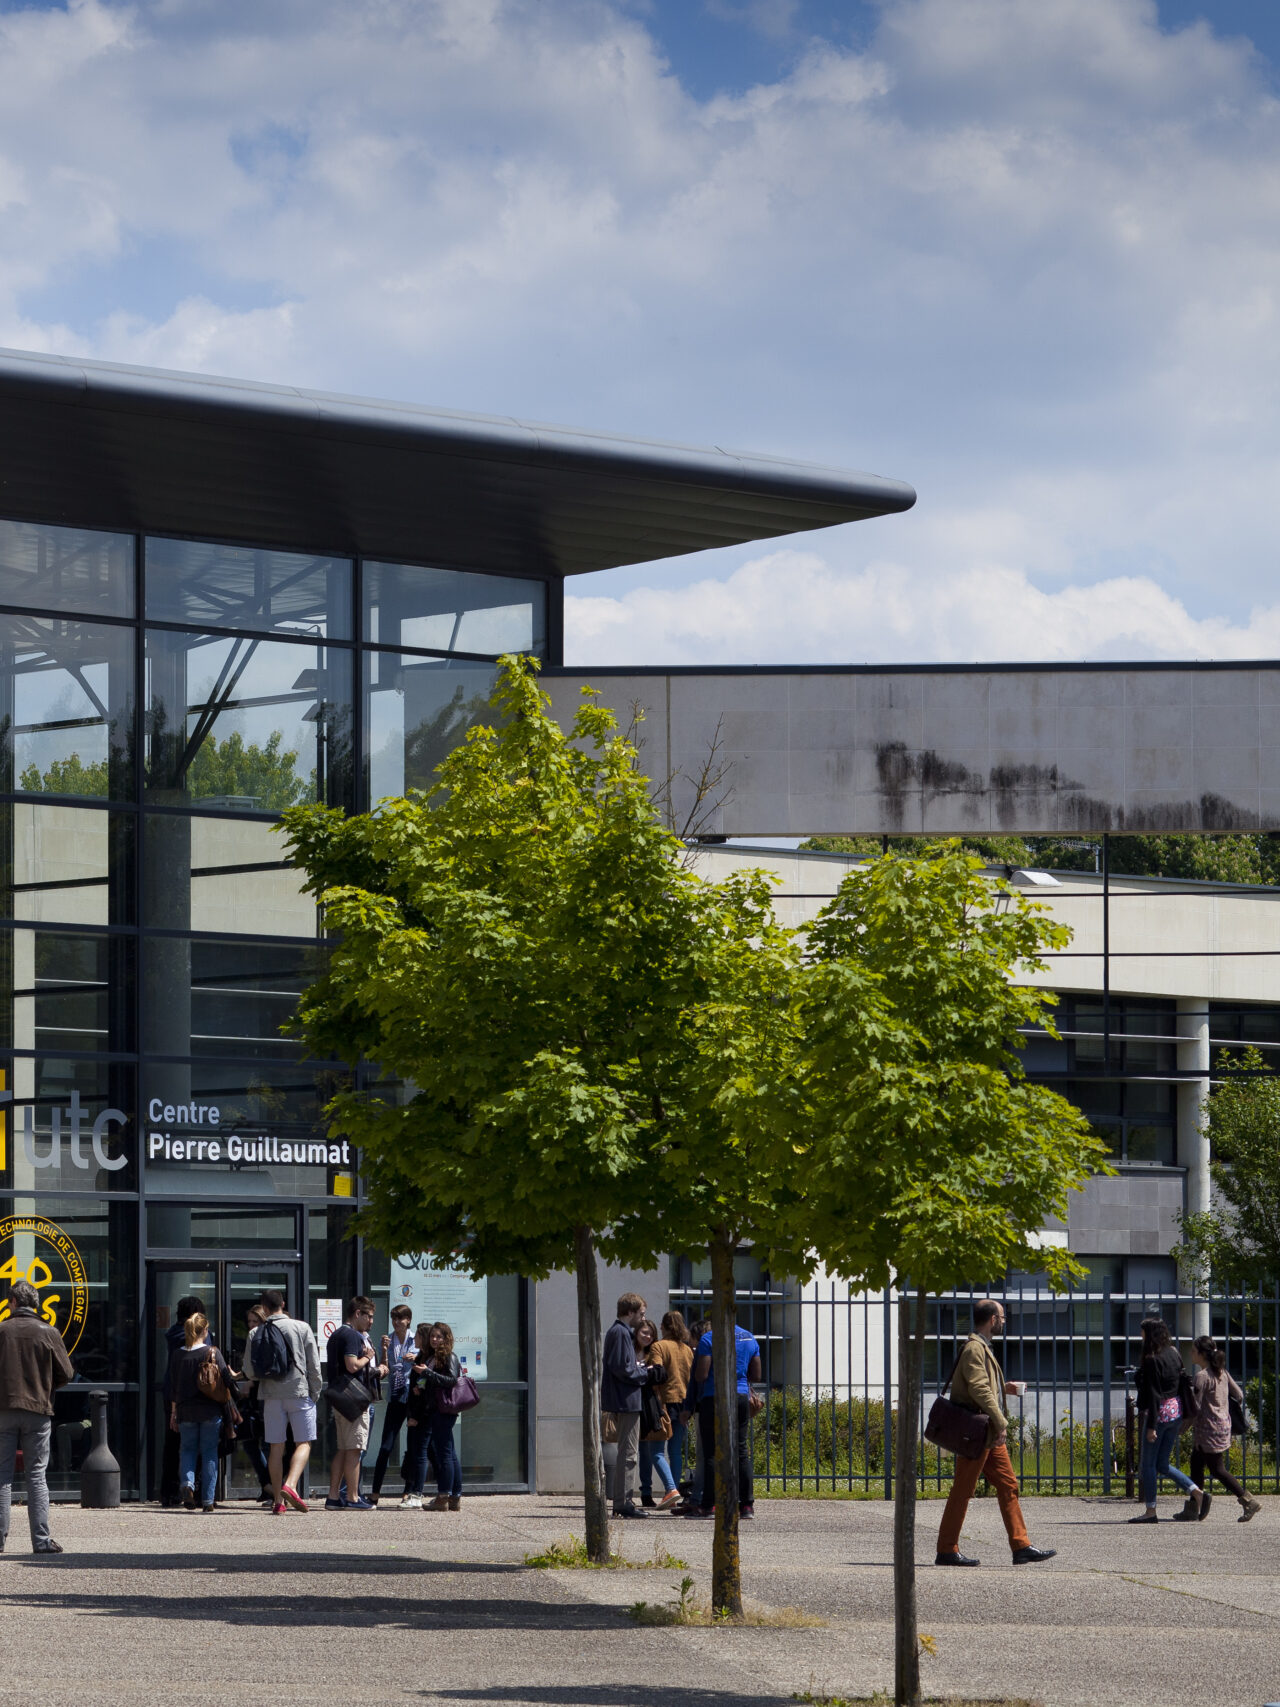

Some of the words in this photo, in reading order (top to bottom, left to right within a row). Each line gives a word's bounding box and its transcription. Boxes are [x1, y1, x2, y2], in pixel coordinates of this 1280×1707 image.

[23, 1090, 128, 1171] utc
[149, 1098, 220, 1125] Centre
[149, 1133, 221, 1161] Pierre
[227, 1135, 350, 1164] Guillaumat
[57, 1236, 71, 1254] DE
[67, 1252, 85, 1324] COMPIEGNE
